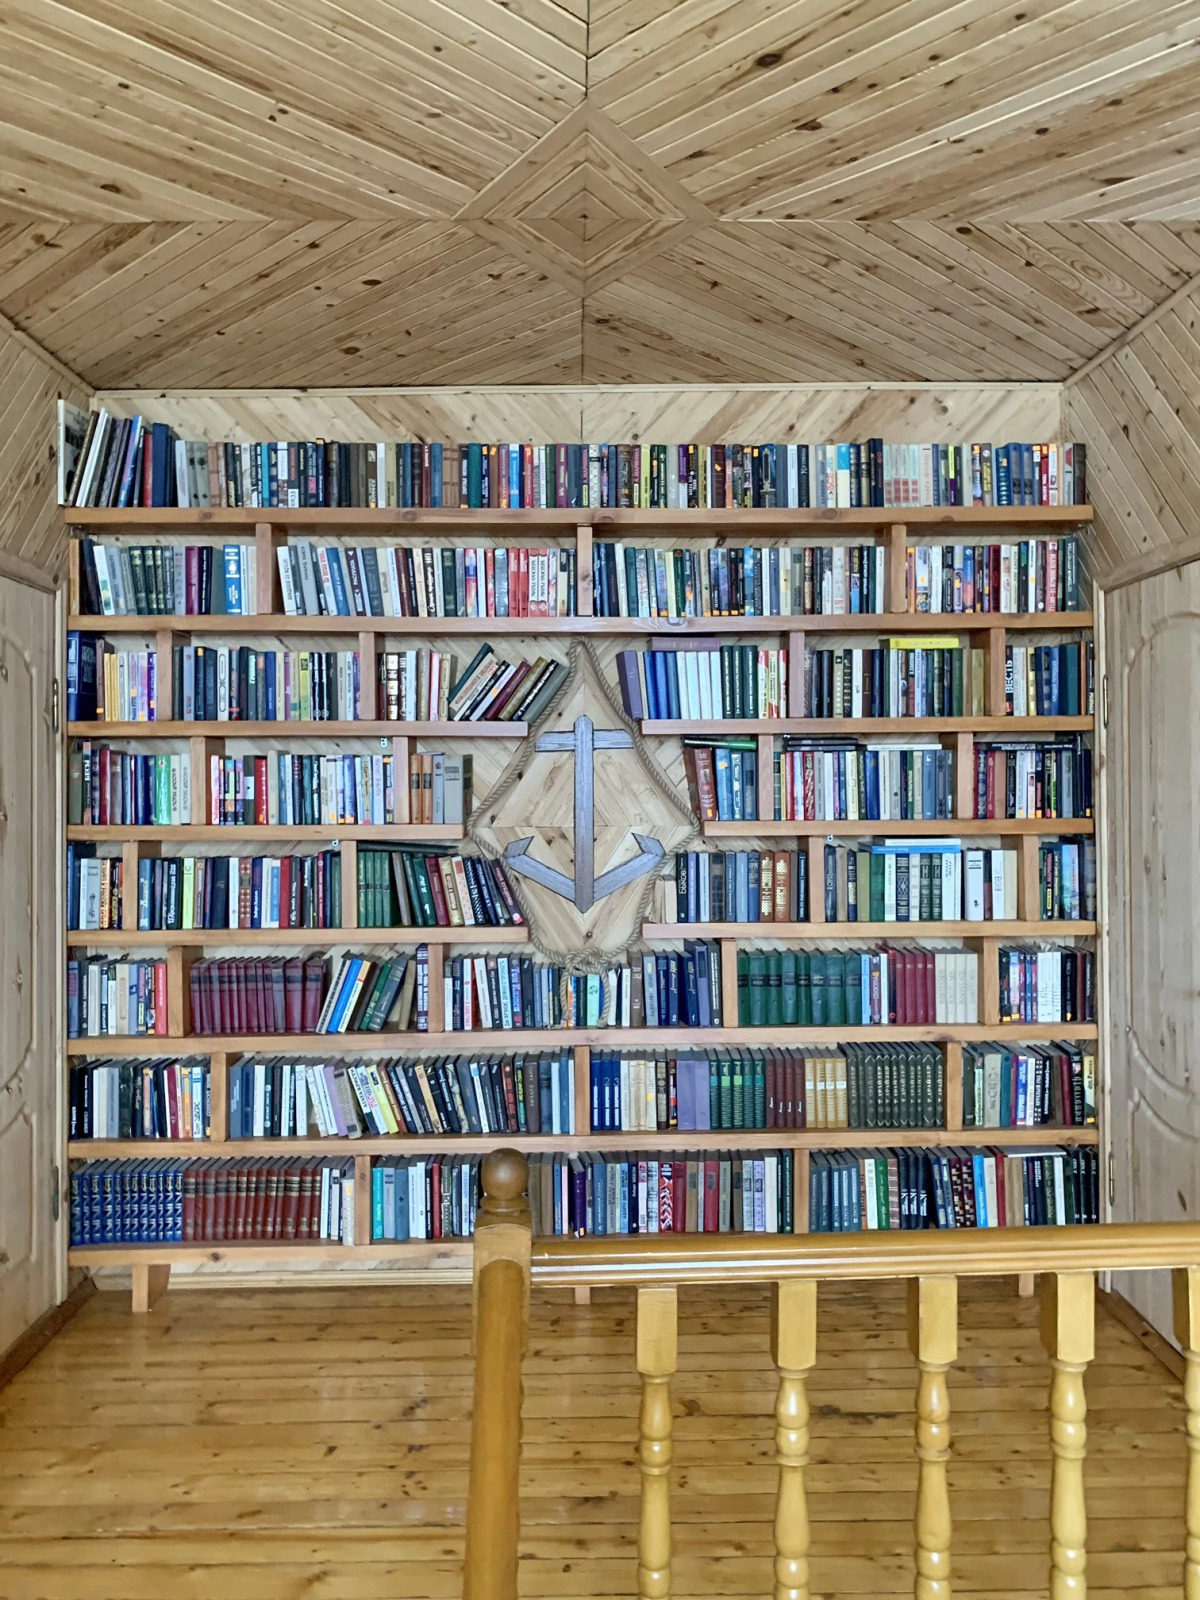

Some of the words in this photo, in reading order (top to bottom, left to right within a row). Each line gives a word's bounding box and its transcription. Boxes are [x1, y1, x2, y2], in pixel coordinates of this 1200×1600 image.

[350, 560, 358, 585] РАСПЛАТА
[678, 870, 687, 894] Быков
[349, 1068, 361, 1091] КРИСТИ
[358, 1091, 368, 1107] АГАТА
